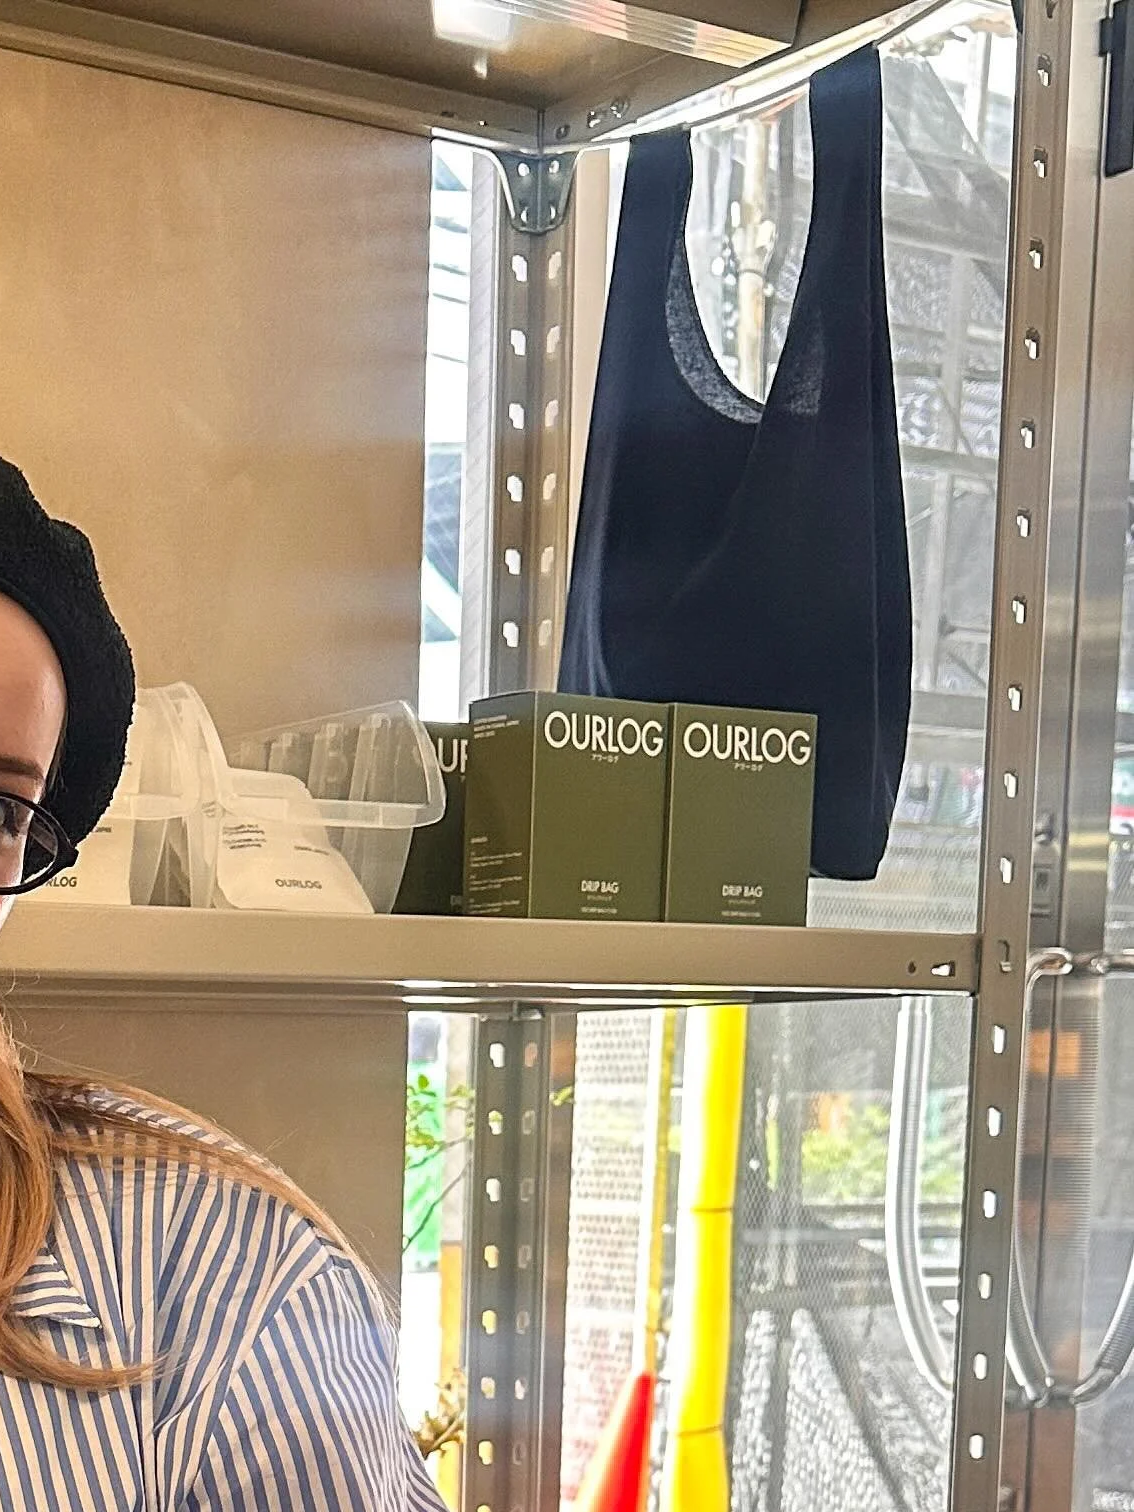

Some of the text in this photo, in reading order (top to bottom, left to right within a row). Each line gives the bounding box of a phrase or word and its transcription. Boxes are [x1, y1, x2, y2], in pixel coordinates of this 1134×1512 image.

[544, 710, 664, 757] OURLOG
[683, 721, 811, 766] OURLOG
[275, 879, 323, 889] OURLOG
[581, 880, 619, 893] DRIP BAG
[722, 884, 763, 897] DRIP BAG
